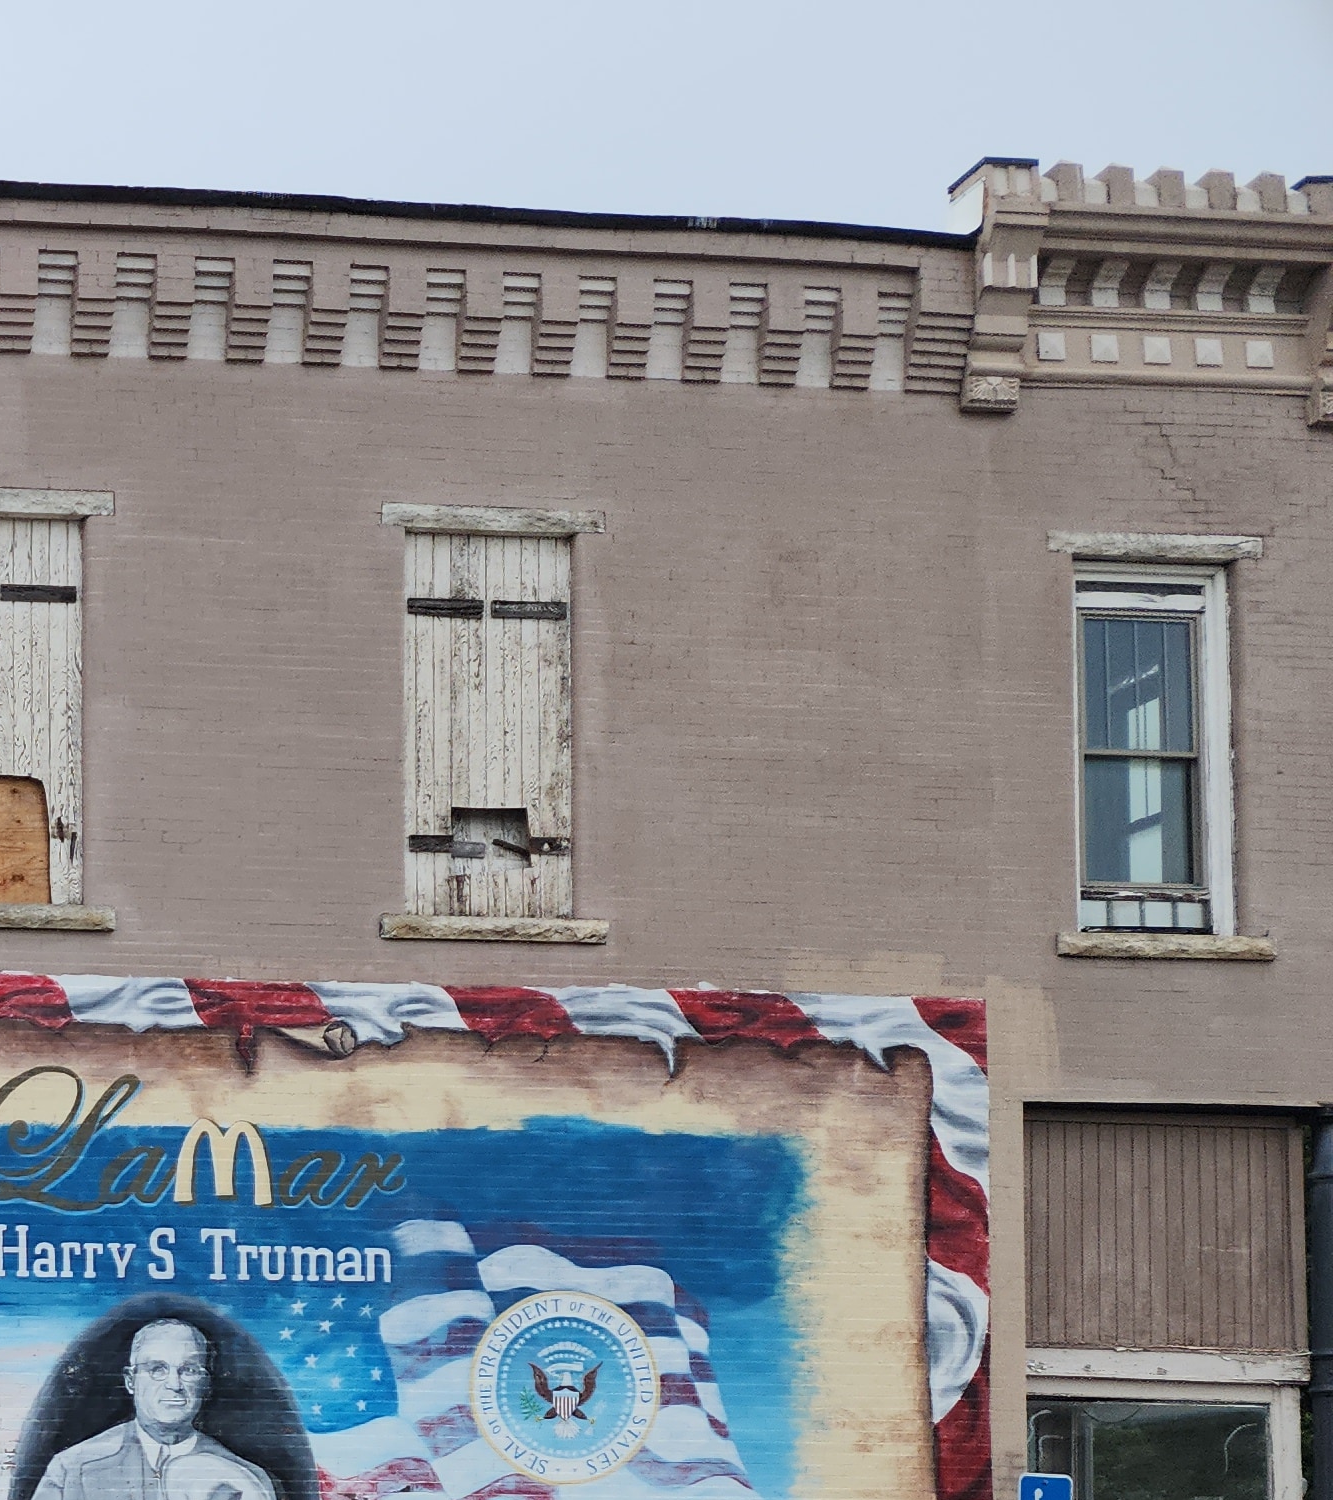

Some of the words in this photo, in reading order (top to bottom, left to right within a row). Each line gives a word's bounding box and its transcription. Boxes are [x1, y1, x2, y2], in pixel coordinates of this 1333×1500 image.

[148, 1226, 176, 1281] S
[201, 1228, 392, 1284] Truman
[478, 1298, 562, 1379] PRESIDENT
[569, 1301, 584, 1313] OF
